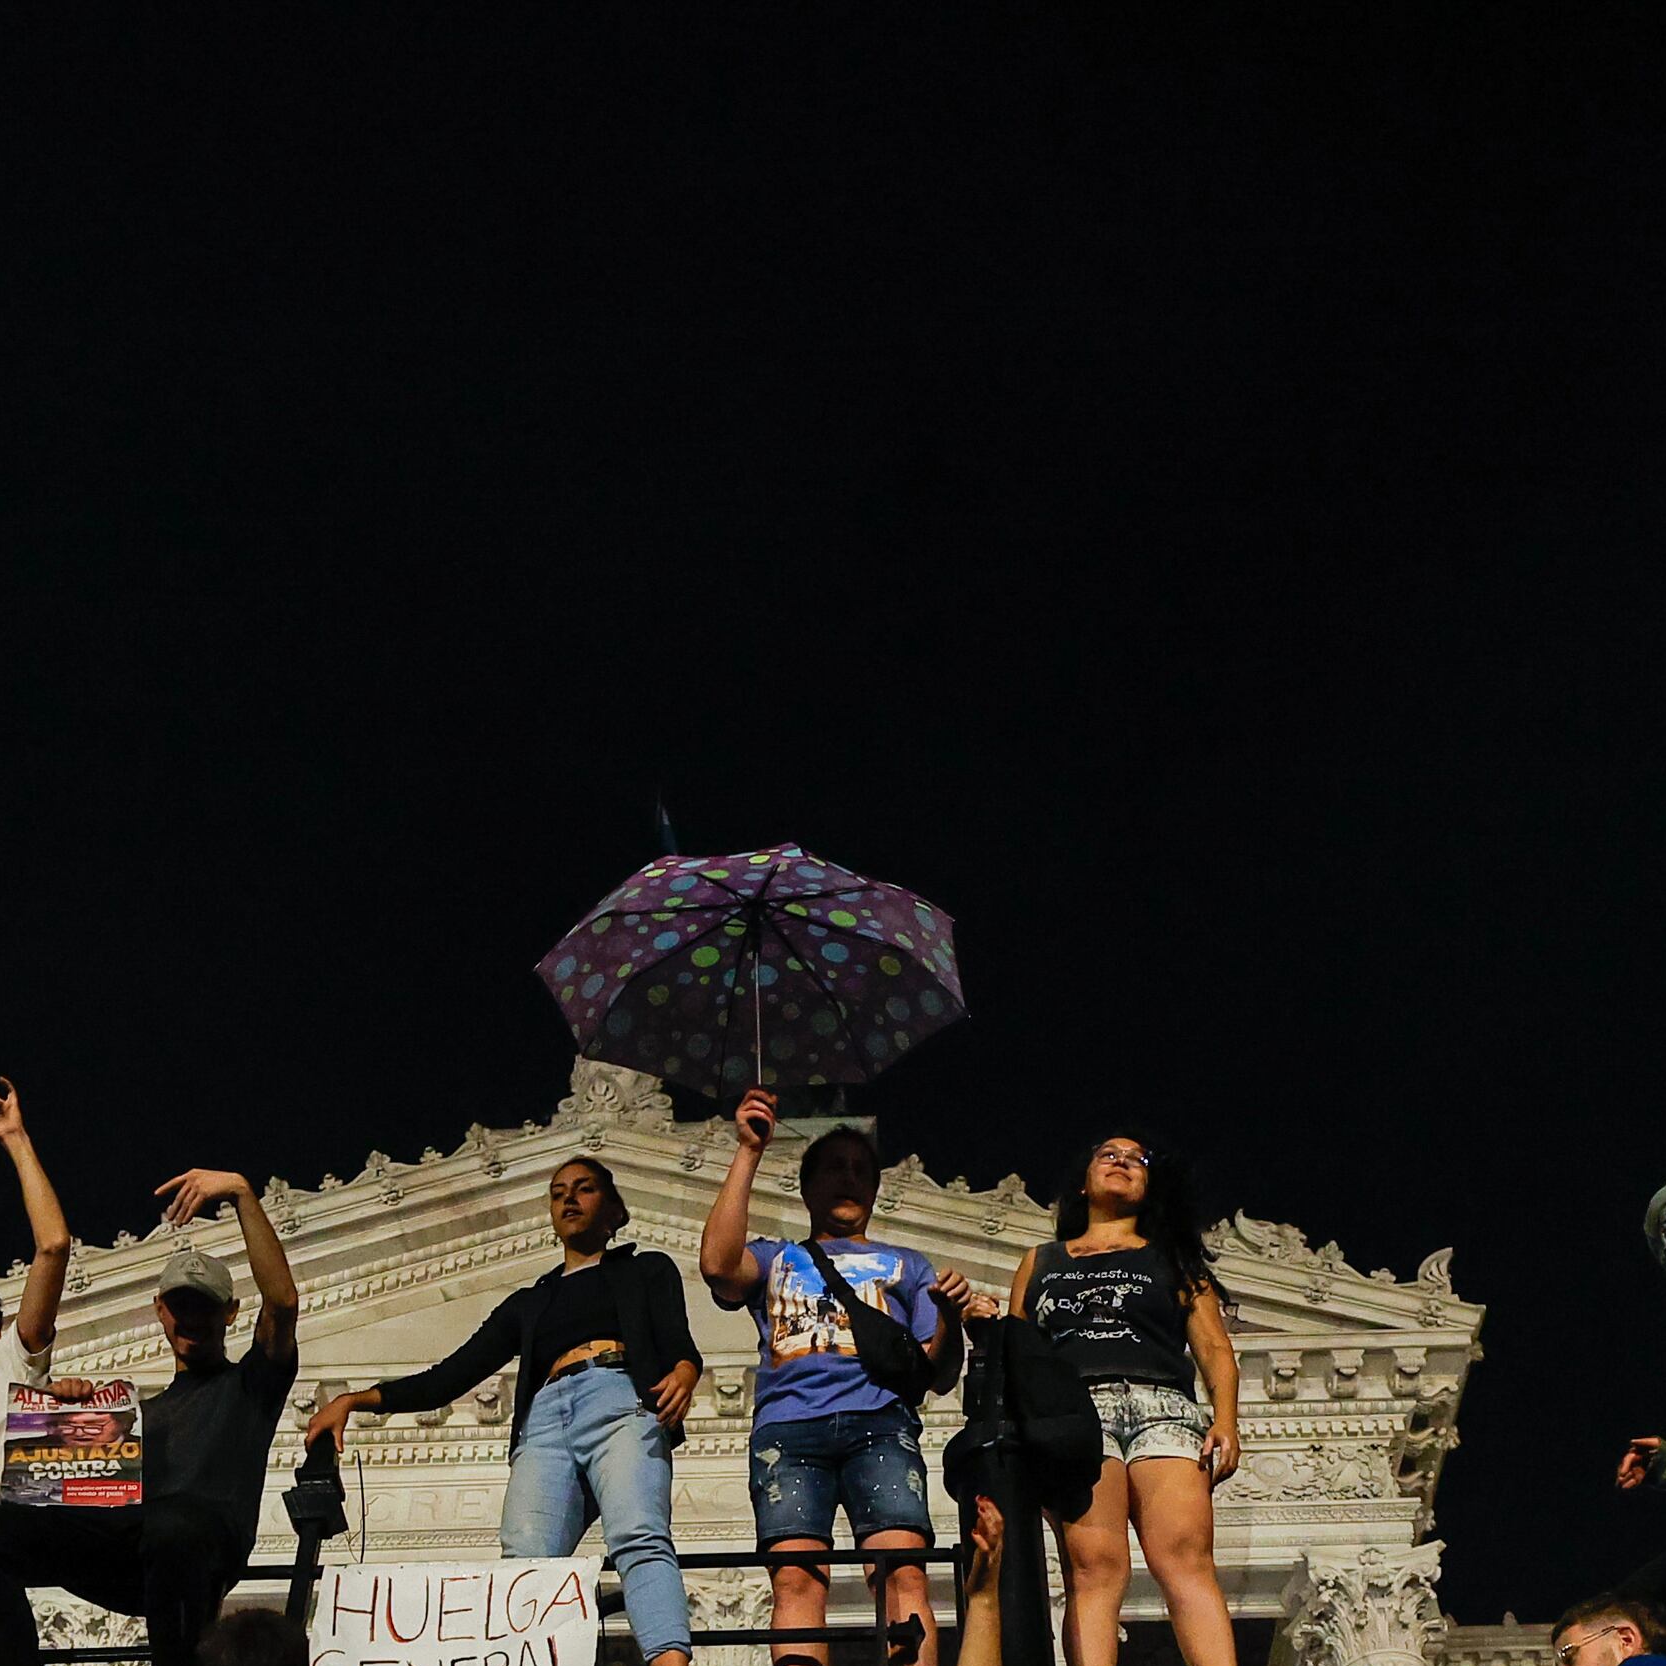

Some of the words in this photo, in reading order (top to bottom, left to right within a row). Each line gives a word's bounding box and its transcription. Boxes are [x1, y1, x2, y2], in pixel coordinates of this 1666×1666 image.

[8, 1441, 140, 1464] AJUSTAZO
[28, 1460, 122, 1474] CONTRA
[332, 1569, 587, 1643] HUELGA
